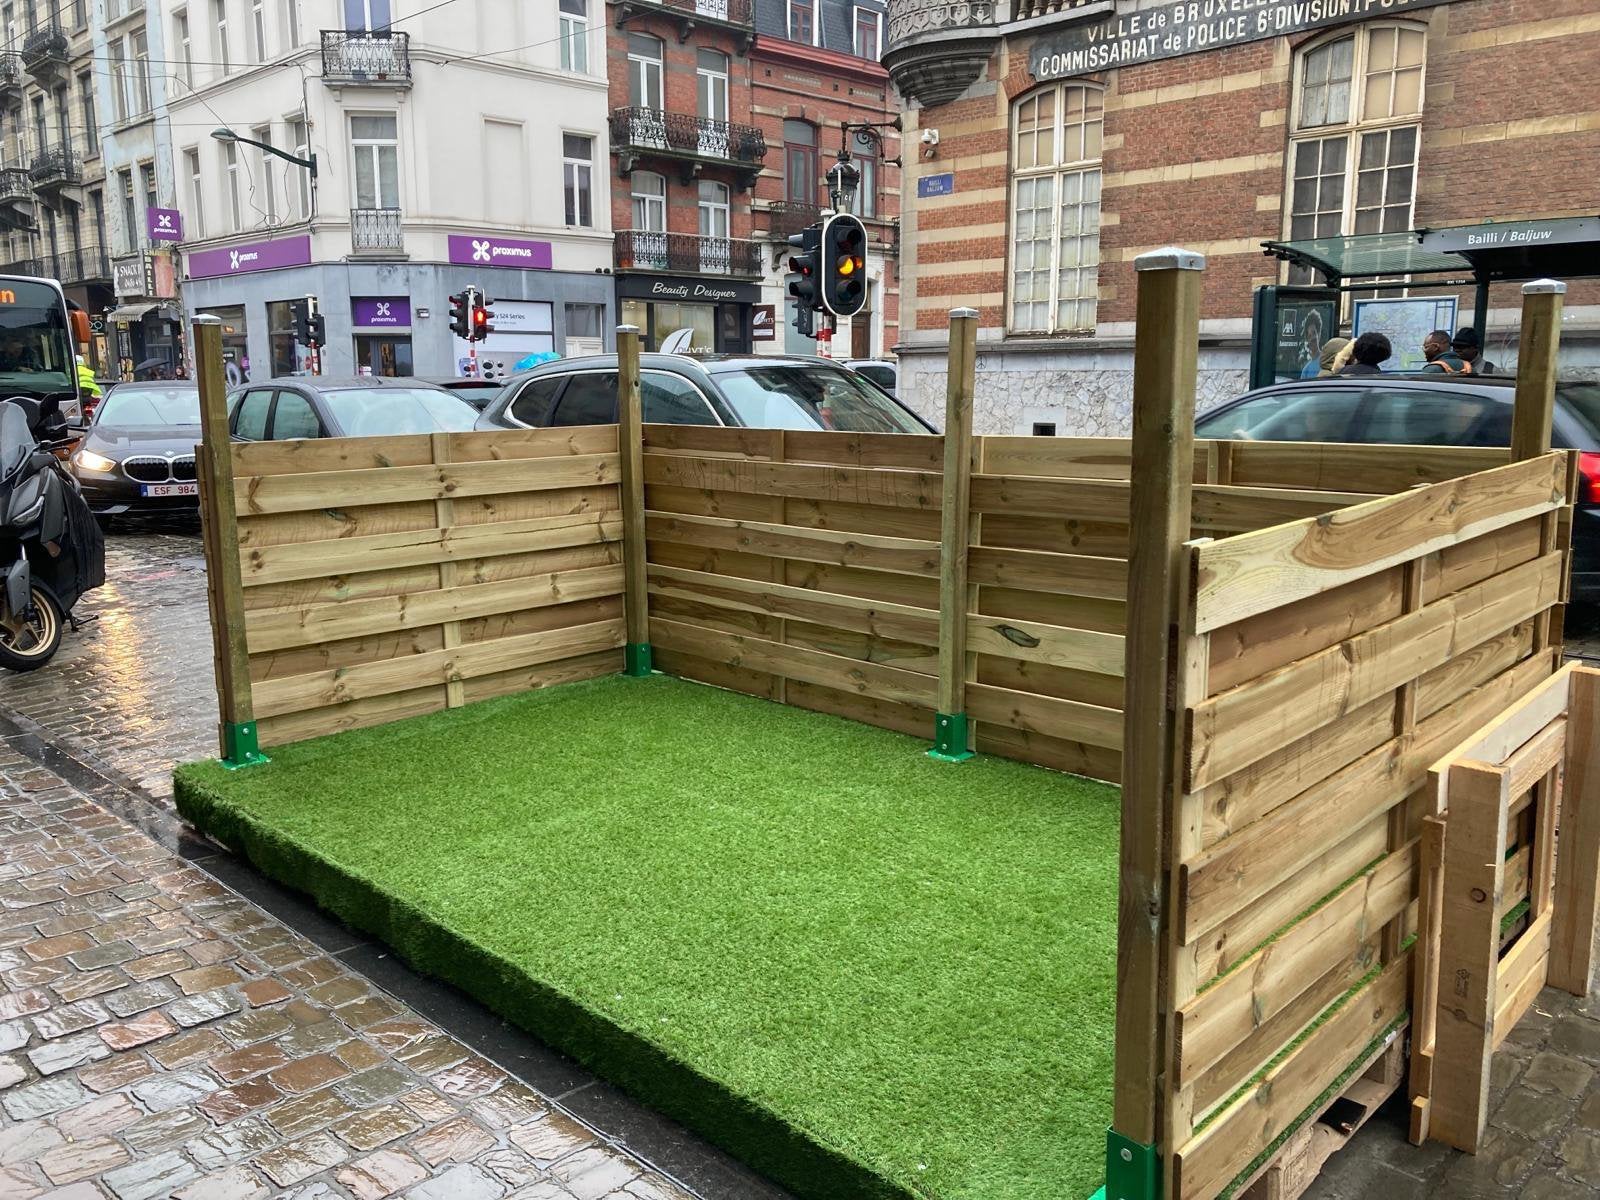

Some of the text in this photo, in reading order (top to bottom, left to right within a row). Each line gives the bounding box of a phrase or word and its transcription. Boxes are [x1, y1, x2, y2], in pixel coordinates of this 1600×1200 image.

[1087, 16, 1141, 42] VILLE
[1147, 12, 1166, 29] de
[1040, 34, 1160, 76] COMMISSARIAT
[1163, 33, 1182, 50] de
[1187, 15, 1247, 48] POLICE
[1275, 0, 1350, 30] DIVISION
[1467, 232, 1498, 245] Bailli
[1509, 229, 1553, 242] Baljuw
[492, 246, 532, 257] proximus
[652, 282, 737, 300] Beauty Designer
[371, 316, 397, 324] proximus
[154, 485, 196, 496] ESF 984
